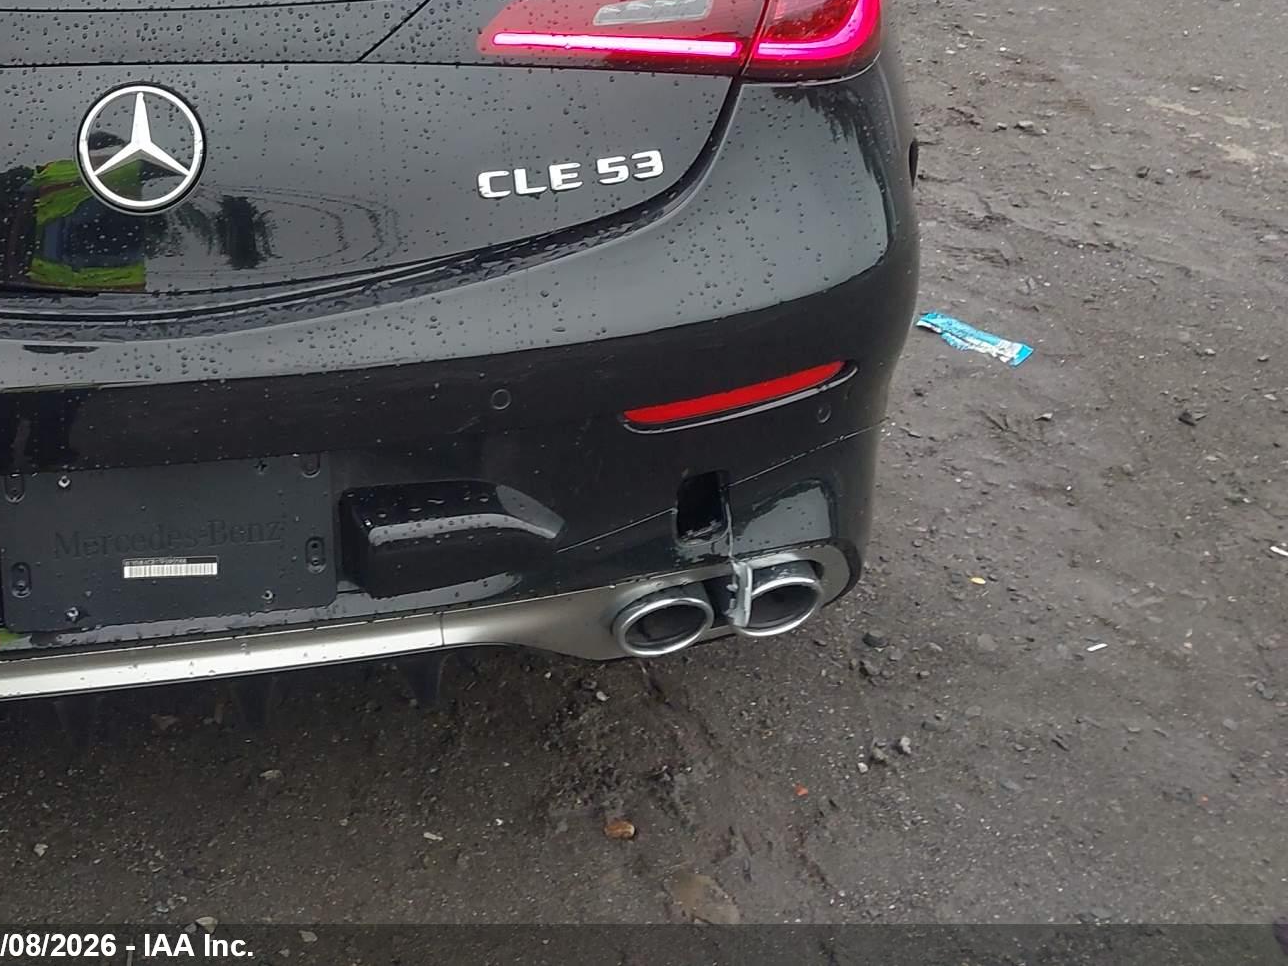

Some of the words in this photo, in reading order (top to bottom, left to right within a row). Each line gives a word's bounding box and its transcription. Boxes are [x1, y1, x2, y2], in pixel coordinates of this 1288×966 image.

[477, 162, 584, 199] CLE
[596, 149, 664, 184] 53
[54, 518, 282, 558] Mercedes-Benz
